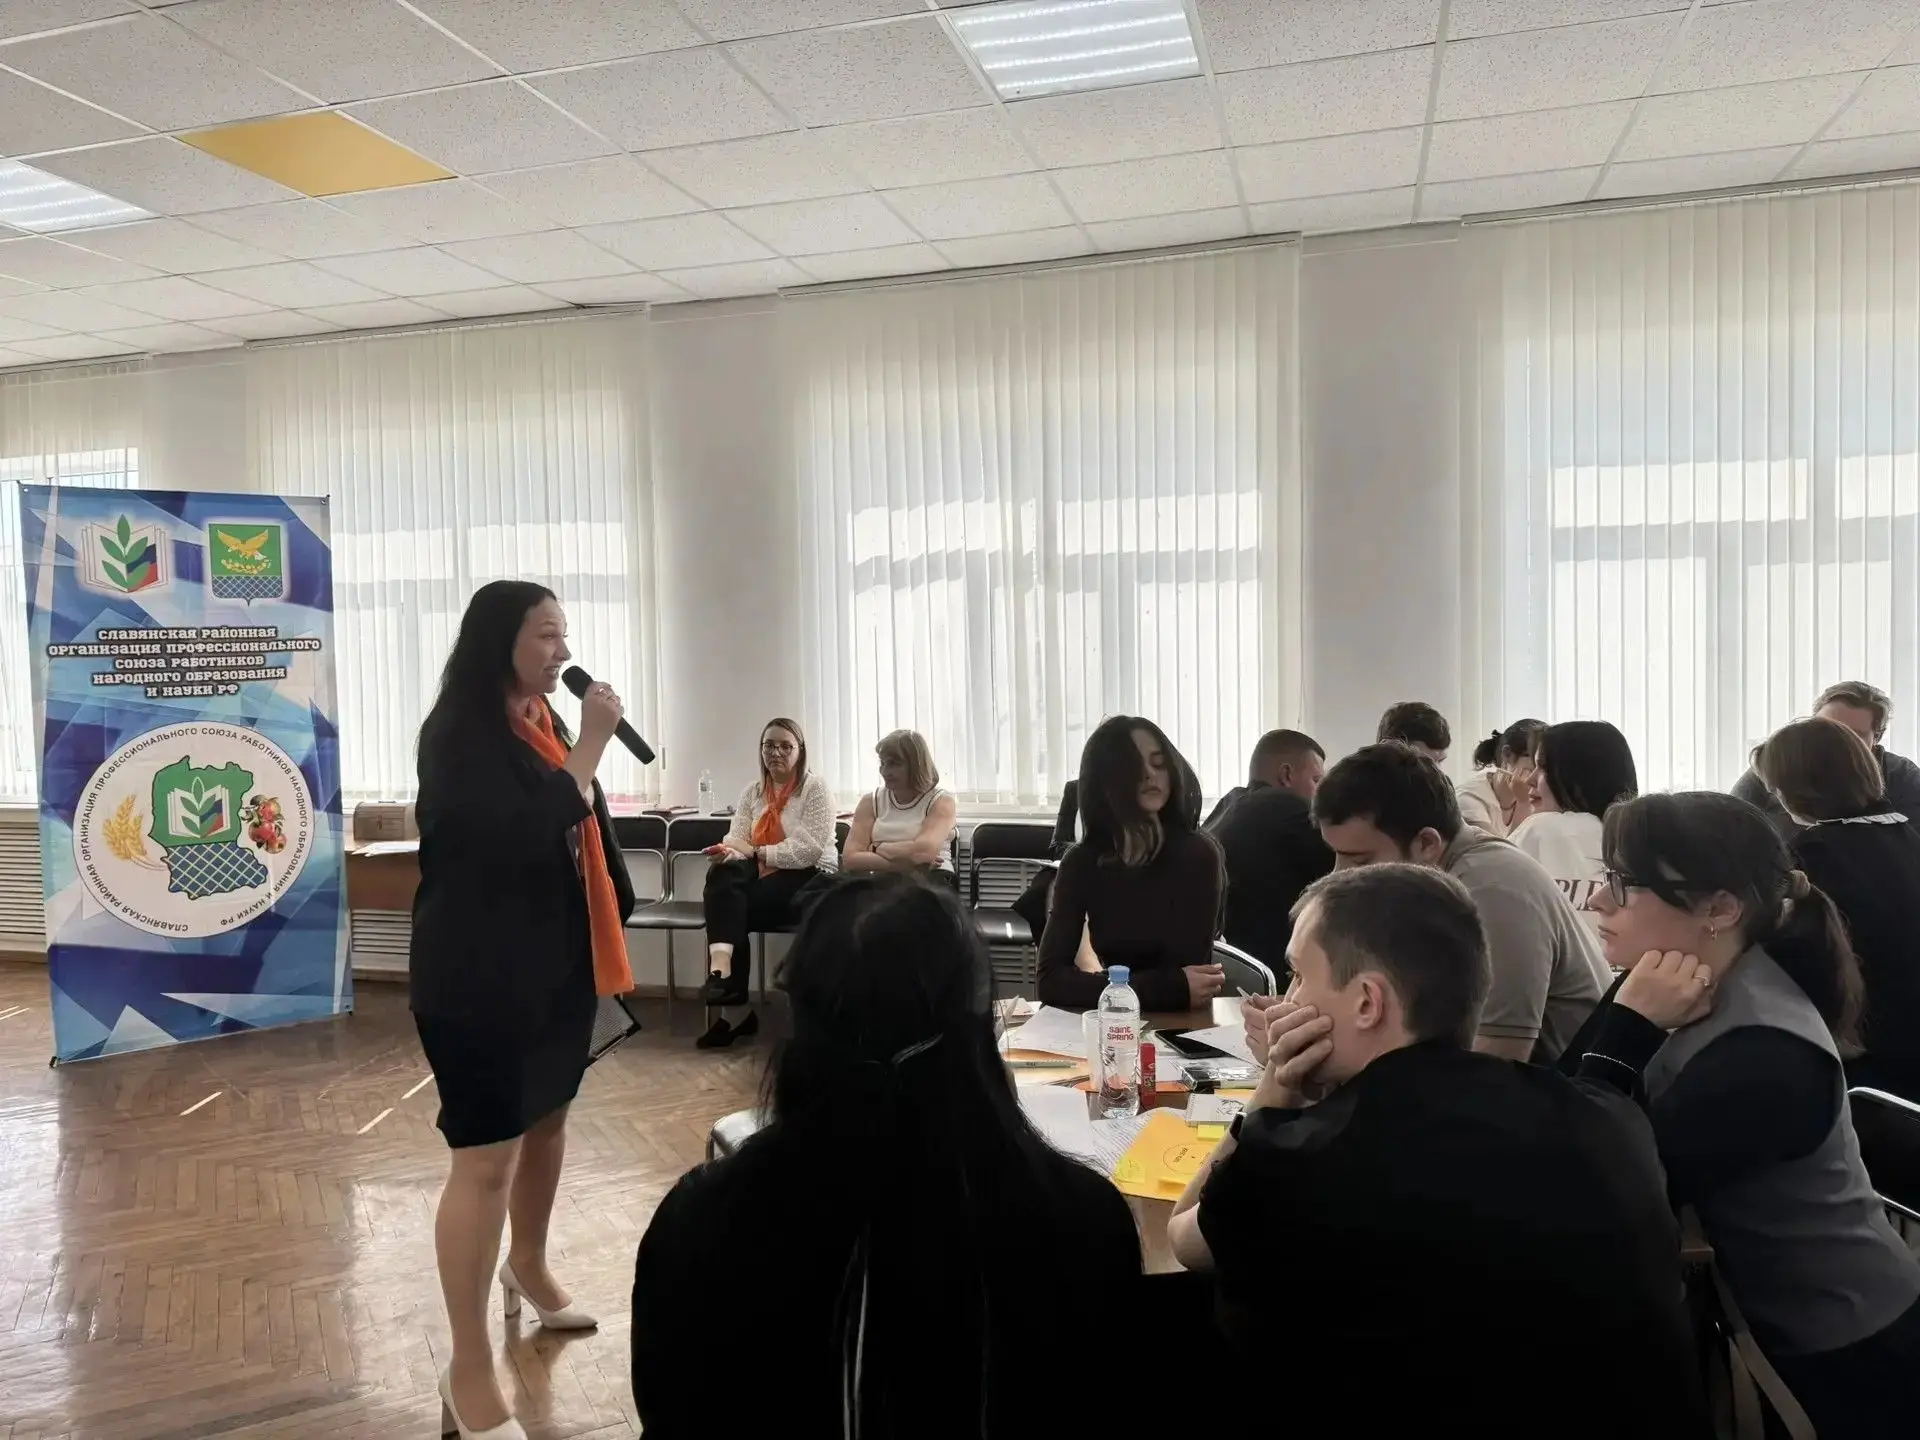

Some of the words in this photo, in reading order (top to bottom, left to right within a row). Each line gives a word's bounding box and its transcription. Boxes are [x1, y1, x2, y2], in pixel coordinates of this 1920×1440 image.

[98, 628, 197, 640] СЛАВЯНСКАЯ
[201, 626, 277, 639] РАЙОННАЯ
[48, 644, 161, 656] ОРГАНИЗАЦИЯ
[166, 640, 320, 654] ПРОФЕССИОНАЛЬНОГО
[115, 658, 166, 669] СОЮЗА
[171, 656, 264, 668] РАБОТНИКОВ
[92, 671, 181, 684] НАРОДНОГО
[185, 668, 286, 682] ОБРАЗОВАНИЯ
[162, 685, 213, 697] НАУКИ
[217, 684, 239, 695] РФ
[201, 727, 238, 739] СОЮЗА
[95, 727, 198, 791] ПРОФЕССИОНАЛЬНОГО
[240, 734, 293, 775] РАБОТНИКОВ
[289, 775, 308, 828] НАРОДНОГО
[80, 792, 98, 861] ОРГАНИЗАЦИЯ
[273, 831, 307, 893] ОБРАЗОВАНИЯ
[86, 863, 122, 908] РАЙОННАЯ
[121, 905, 189, 932] СЛАВЯНСКАЯ
[236, 899, 266, 919] НАУКИ
[220, 916, 234, 926] РФ
